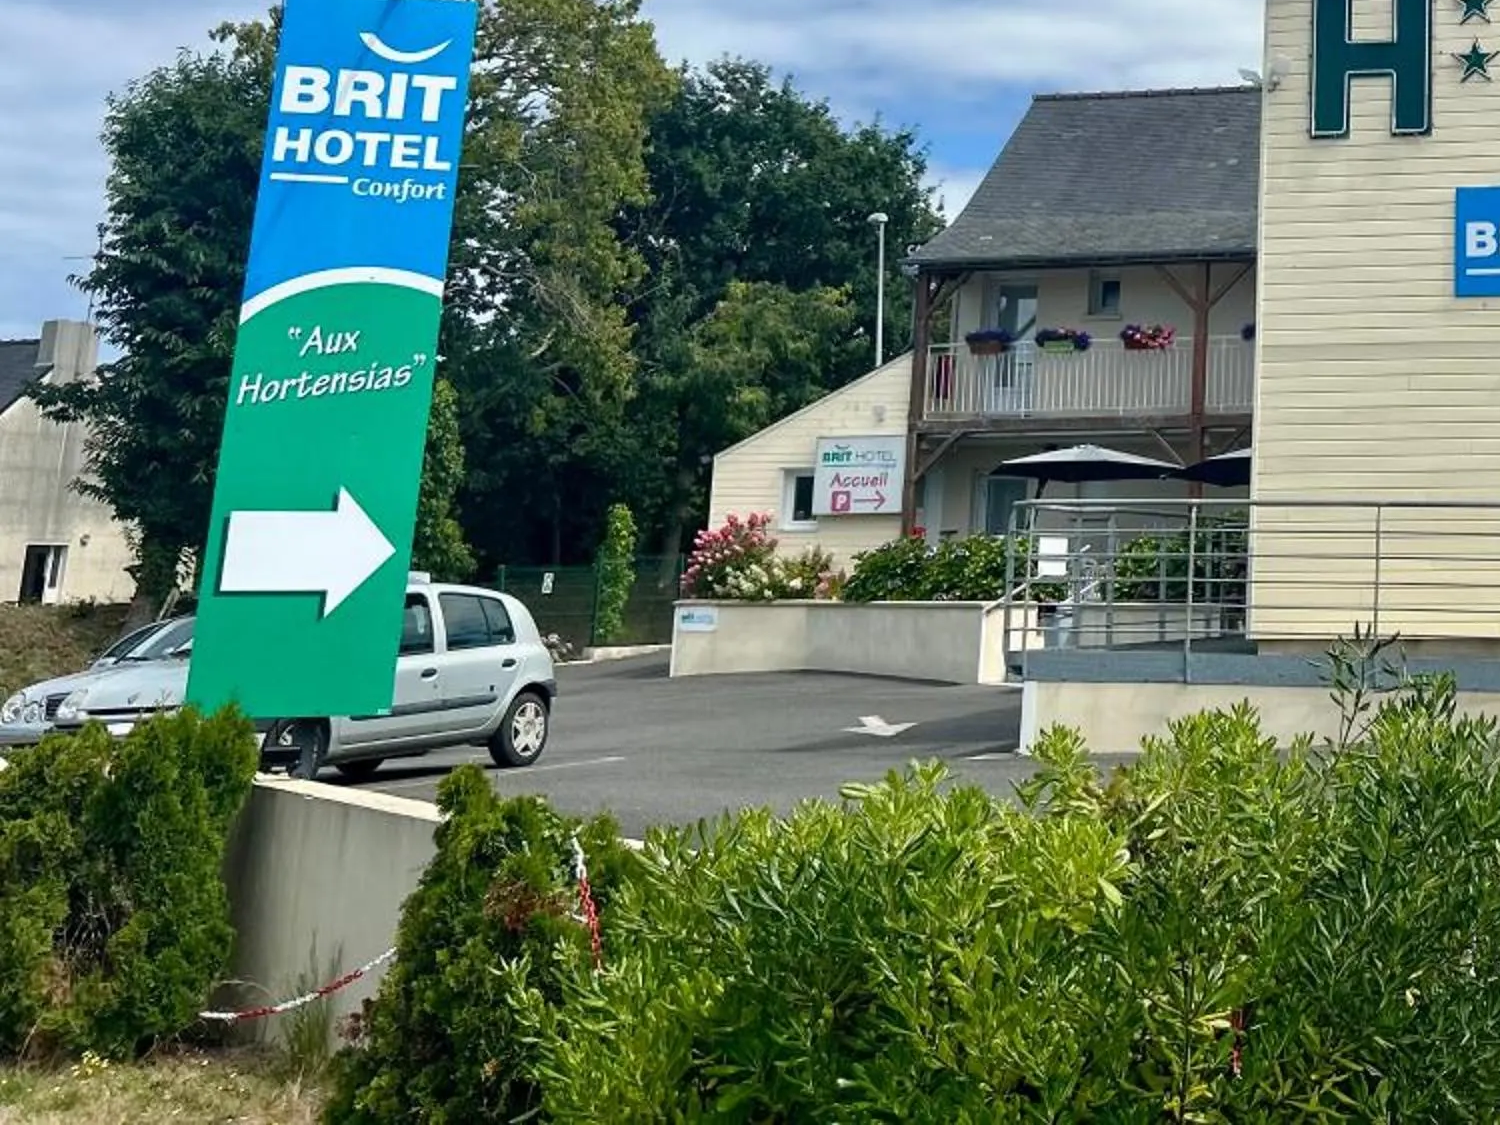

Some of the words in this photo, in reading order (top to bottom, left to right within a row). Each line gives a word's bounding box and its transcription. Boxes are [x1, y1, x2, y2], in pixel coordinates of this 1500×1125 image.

[280, 65, 457, 122] BRIT
[272, 127, 452, 172] HOTEL
[352, 178, 447, 204] Confort
[821, 450, 853, 463] BRIT
[855, 450, 897, 462] HOTEL
[829, 471, 889, 488] Accueil
